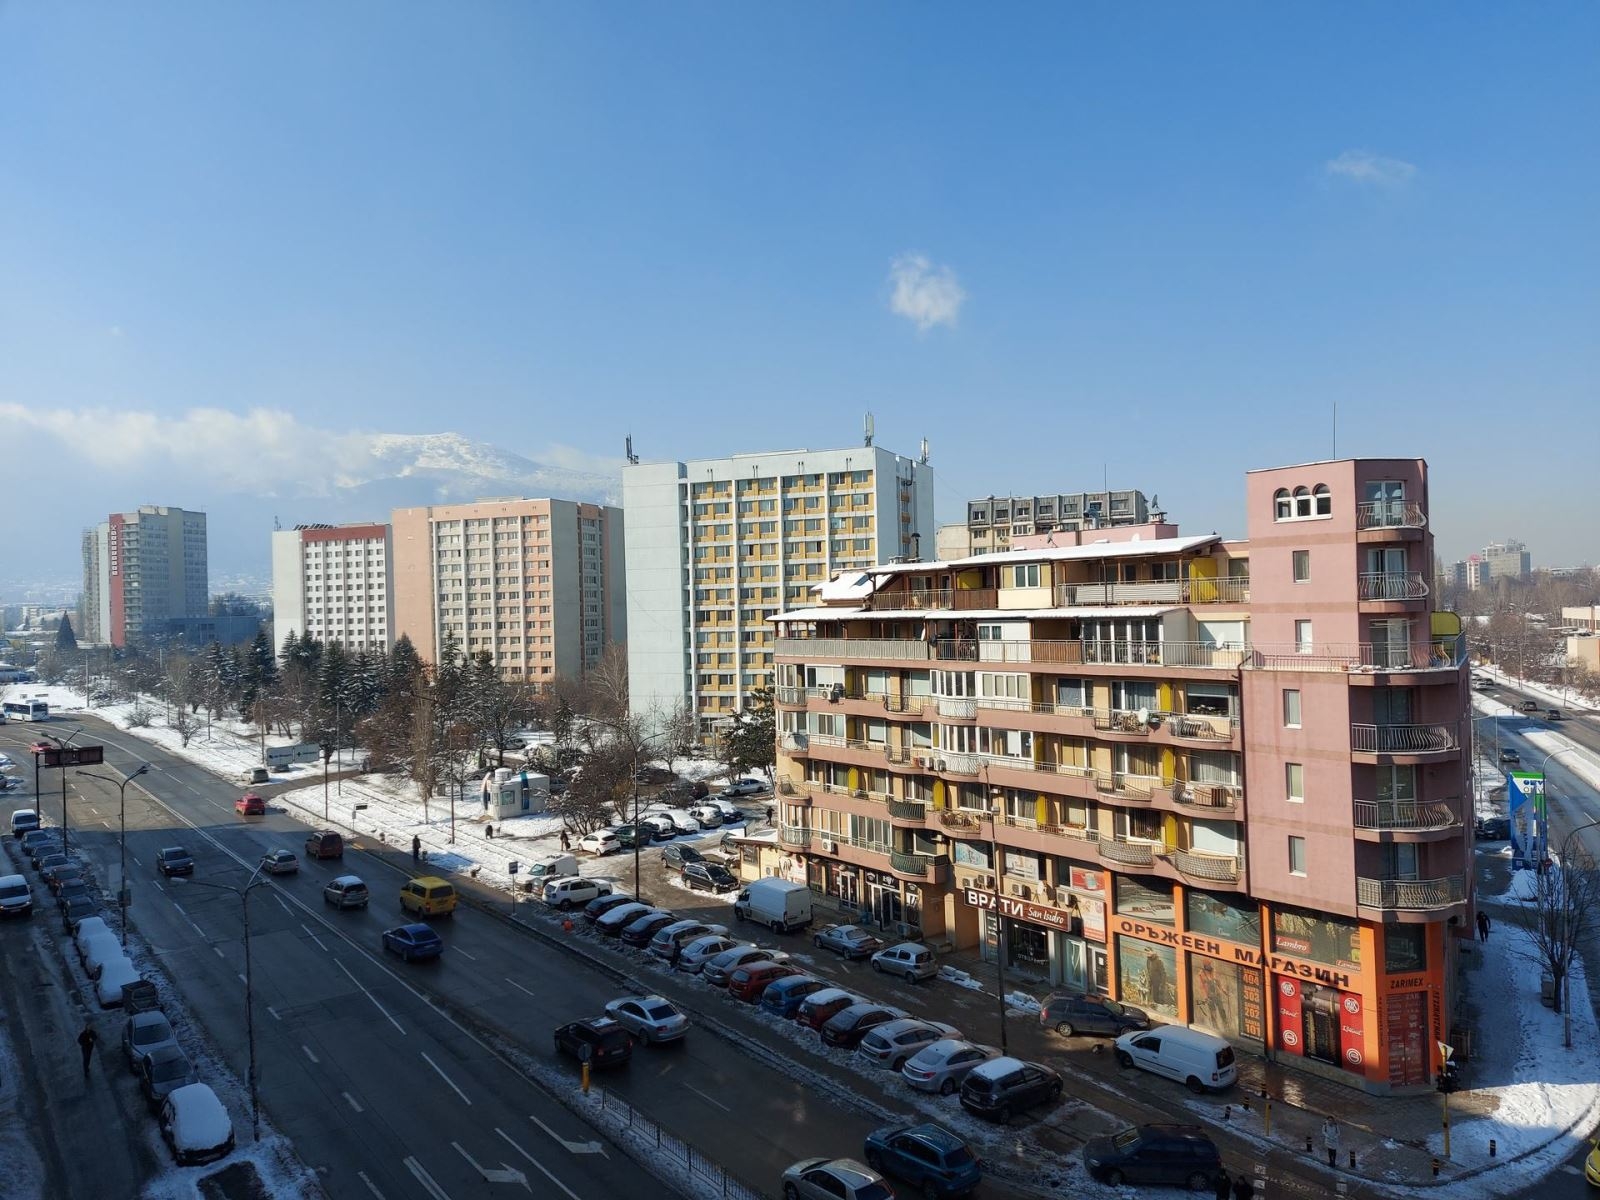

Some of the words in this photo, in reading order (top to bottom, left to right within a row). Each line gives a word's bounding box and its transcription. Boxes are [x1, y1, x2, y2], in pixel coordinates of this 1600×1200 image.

[1027, 906, 1042, 919] San
[1043, 910, 1064, 924] Isidro
[1276, 937, 1308, 952] Lambro
[1120, 921, 1221, 955] ОРЪЖЕЕН
[1234, 948, 1350, 988] МАГАЗИН
[1390, 977, 1424, 990] ZARIMEX
[1245, 1022, 1261, 1037] 101
